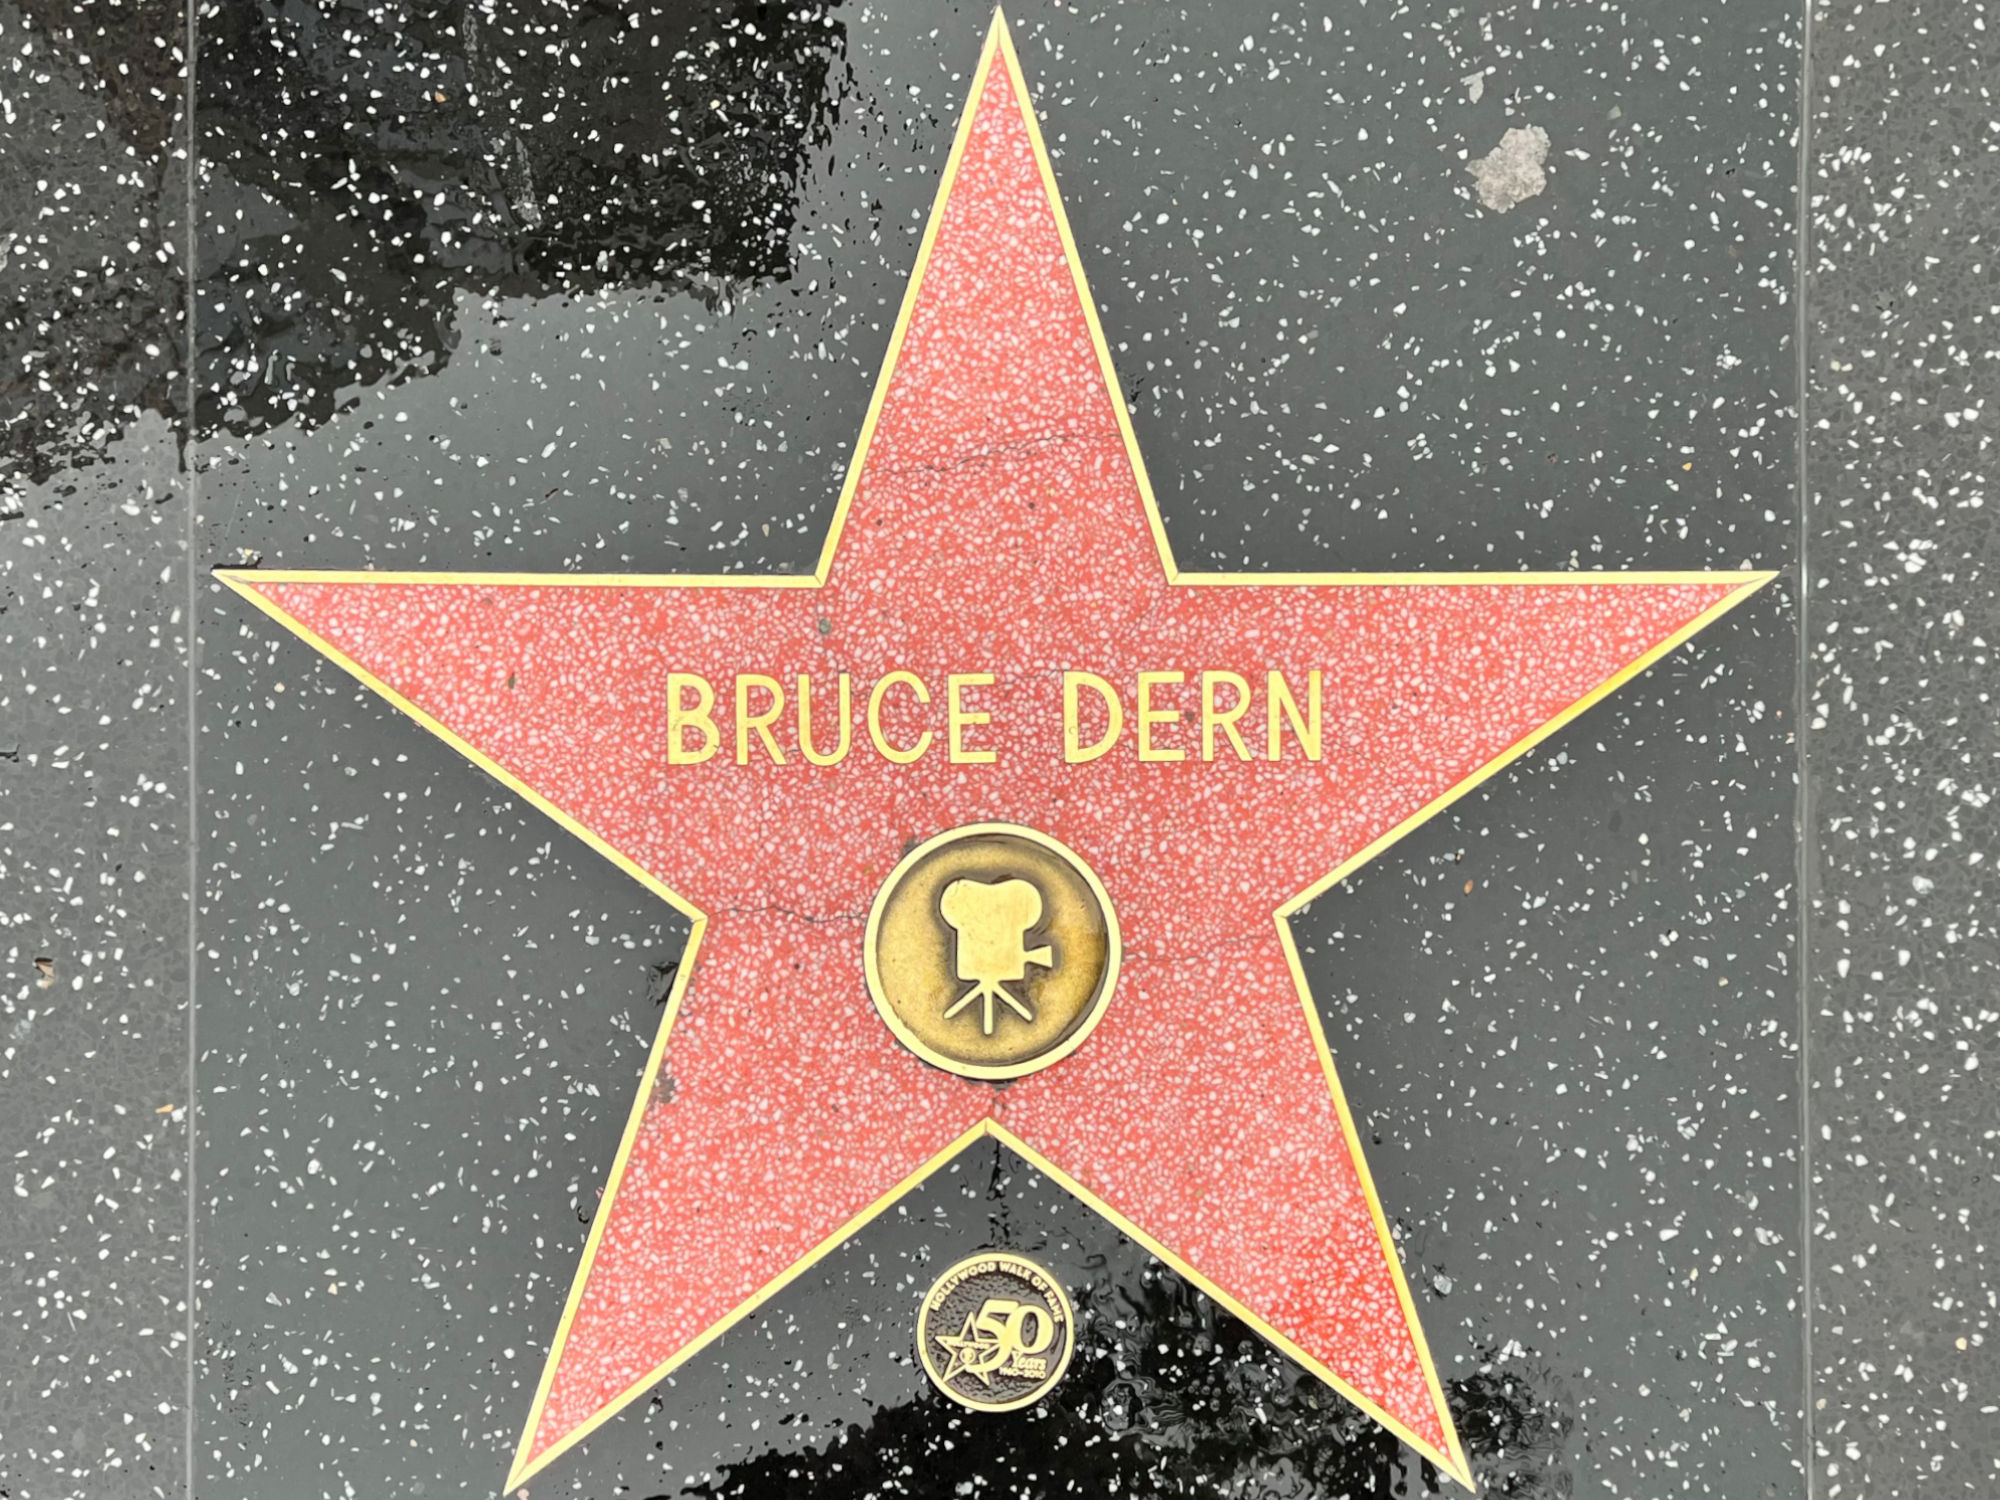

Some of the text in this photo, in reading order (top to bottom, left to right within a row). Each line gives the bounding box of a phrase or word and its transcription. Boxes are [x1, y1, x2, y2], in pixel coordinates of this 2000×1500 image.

[666, 669, 1325, 766] BRUCE DERN
[930, 1261, 1065, 1323] HOLLYWOOD WALK OF FAME
[965, 1299, 1054, 1373] 50
[1010, 1349, 1047, 1370] Years
